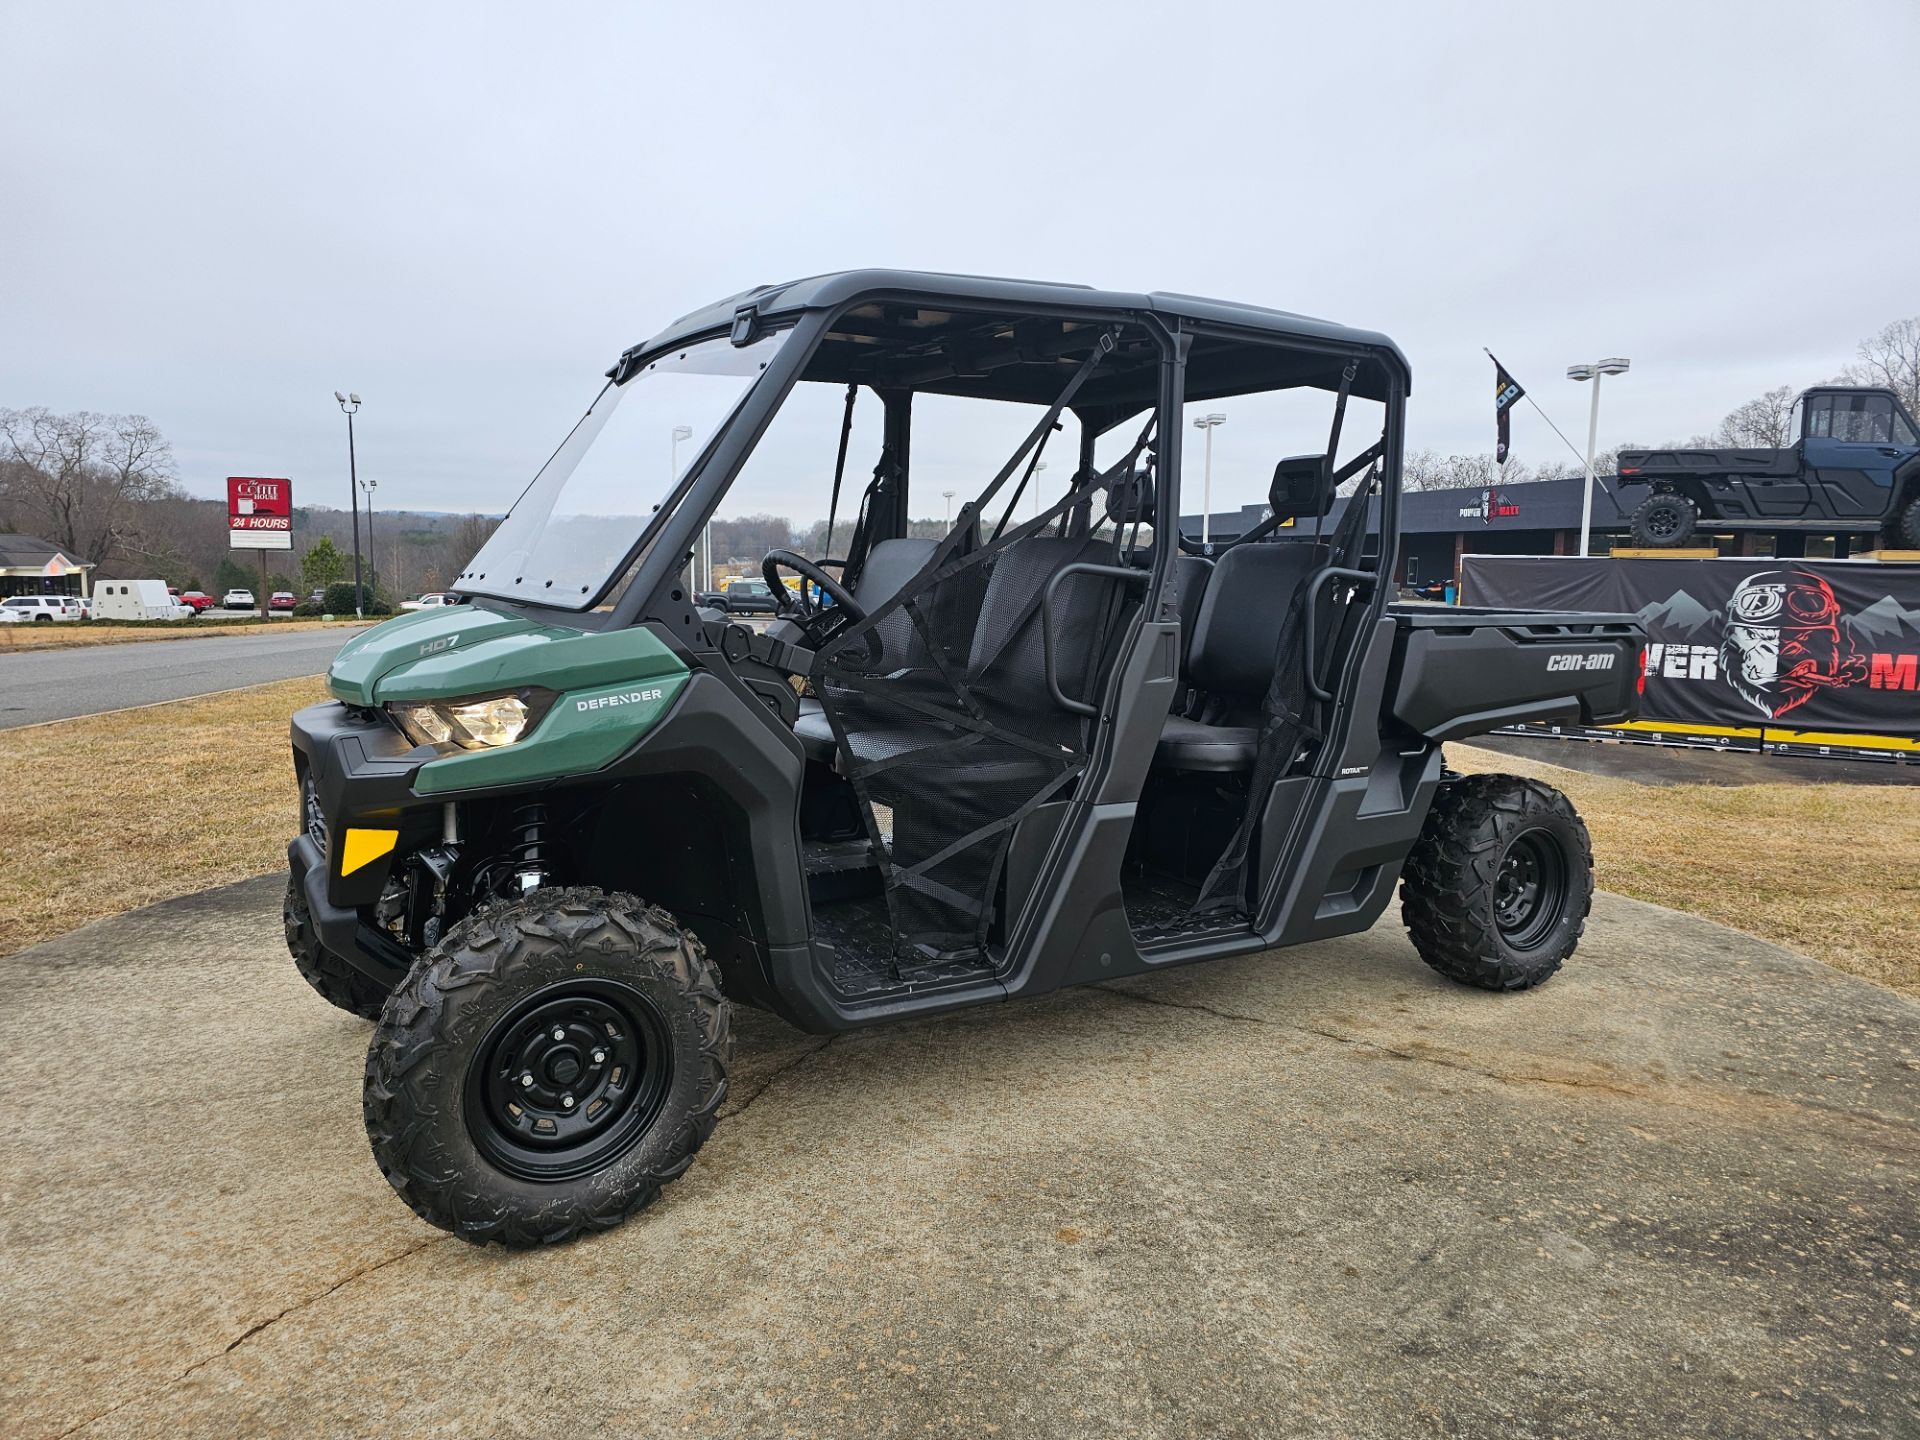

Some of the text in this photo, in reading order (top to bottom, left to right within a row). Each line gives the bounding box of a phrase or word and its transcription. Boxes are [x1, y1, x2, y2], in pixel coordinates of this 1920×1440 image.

[233, 518, 289, 528] 24 HOURS
[419, 634, 460, 656] HD7
[1546, 653, 1616, 672] can-am
[1869, 653, 1920, 691] M
[576, 689, 662, 712] DEFENDER
